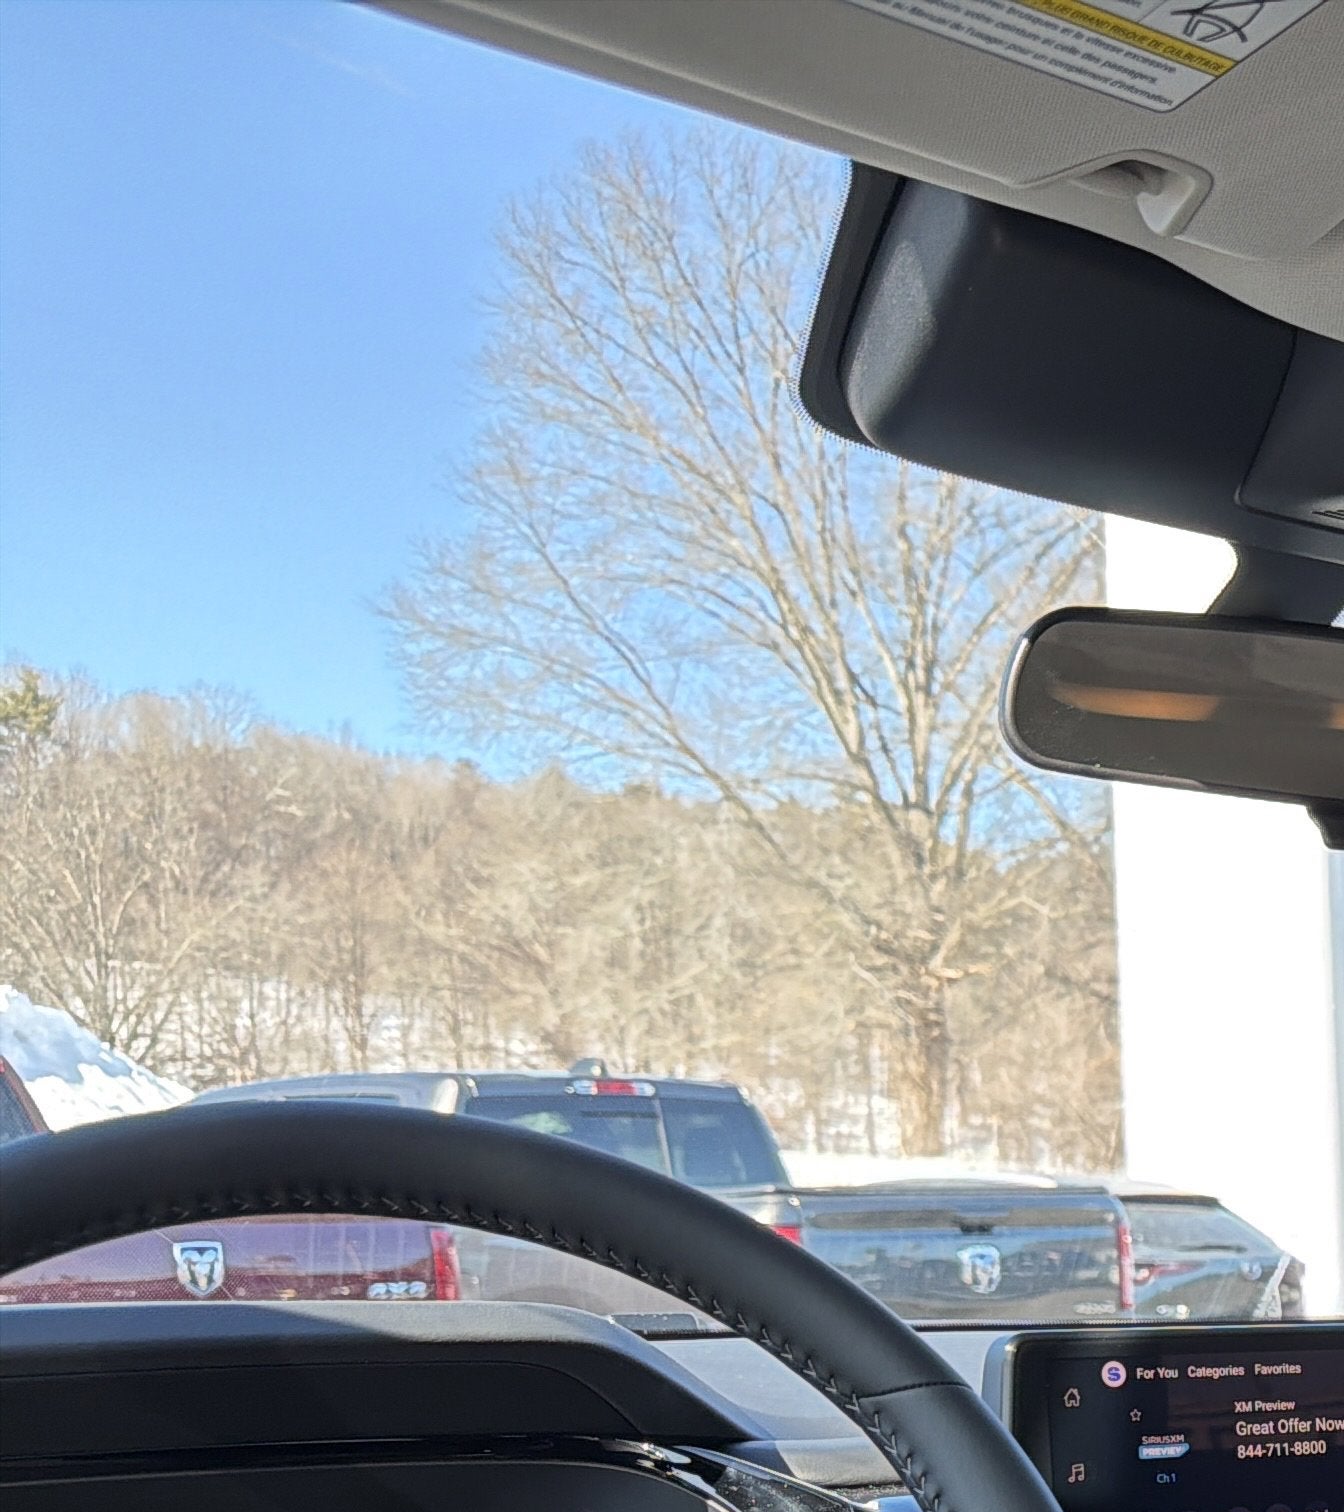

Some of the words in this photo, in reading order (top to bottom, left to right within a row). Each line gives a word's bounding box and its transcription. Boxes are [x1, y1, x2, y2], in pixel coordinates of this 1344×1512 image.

[1137, 1367, 1155, 1379] For
[1157, 1367, 1178, 1378] You
[1187, 1365, 1245, 1380] Categories
[1255, 1363, 1302, 1376] Favorites
[1234, 1401, 1252, 1413] XM
[1255, 1400, 1296, 1411] Preview
[1236, 1420, 1275, 1436] Great
[1278, 1418, 1311, 1434] Offer
[1237, 1440, 1327, 1460] 844-711-8800
[1156, 1473, 1170, 1484] Ch
[1171, 1473, 1177, 1483] 1
